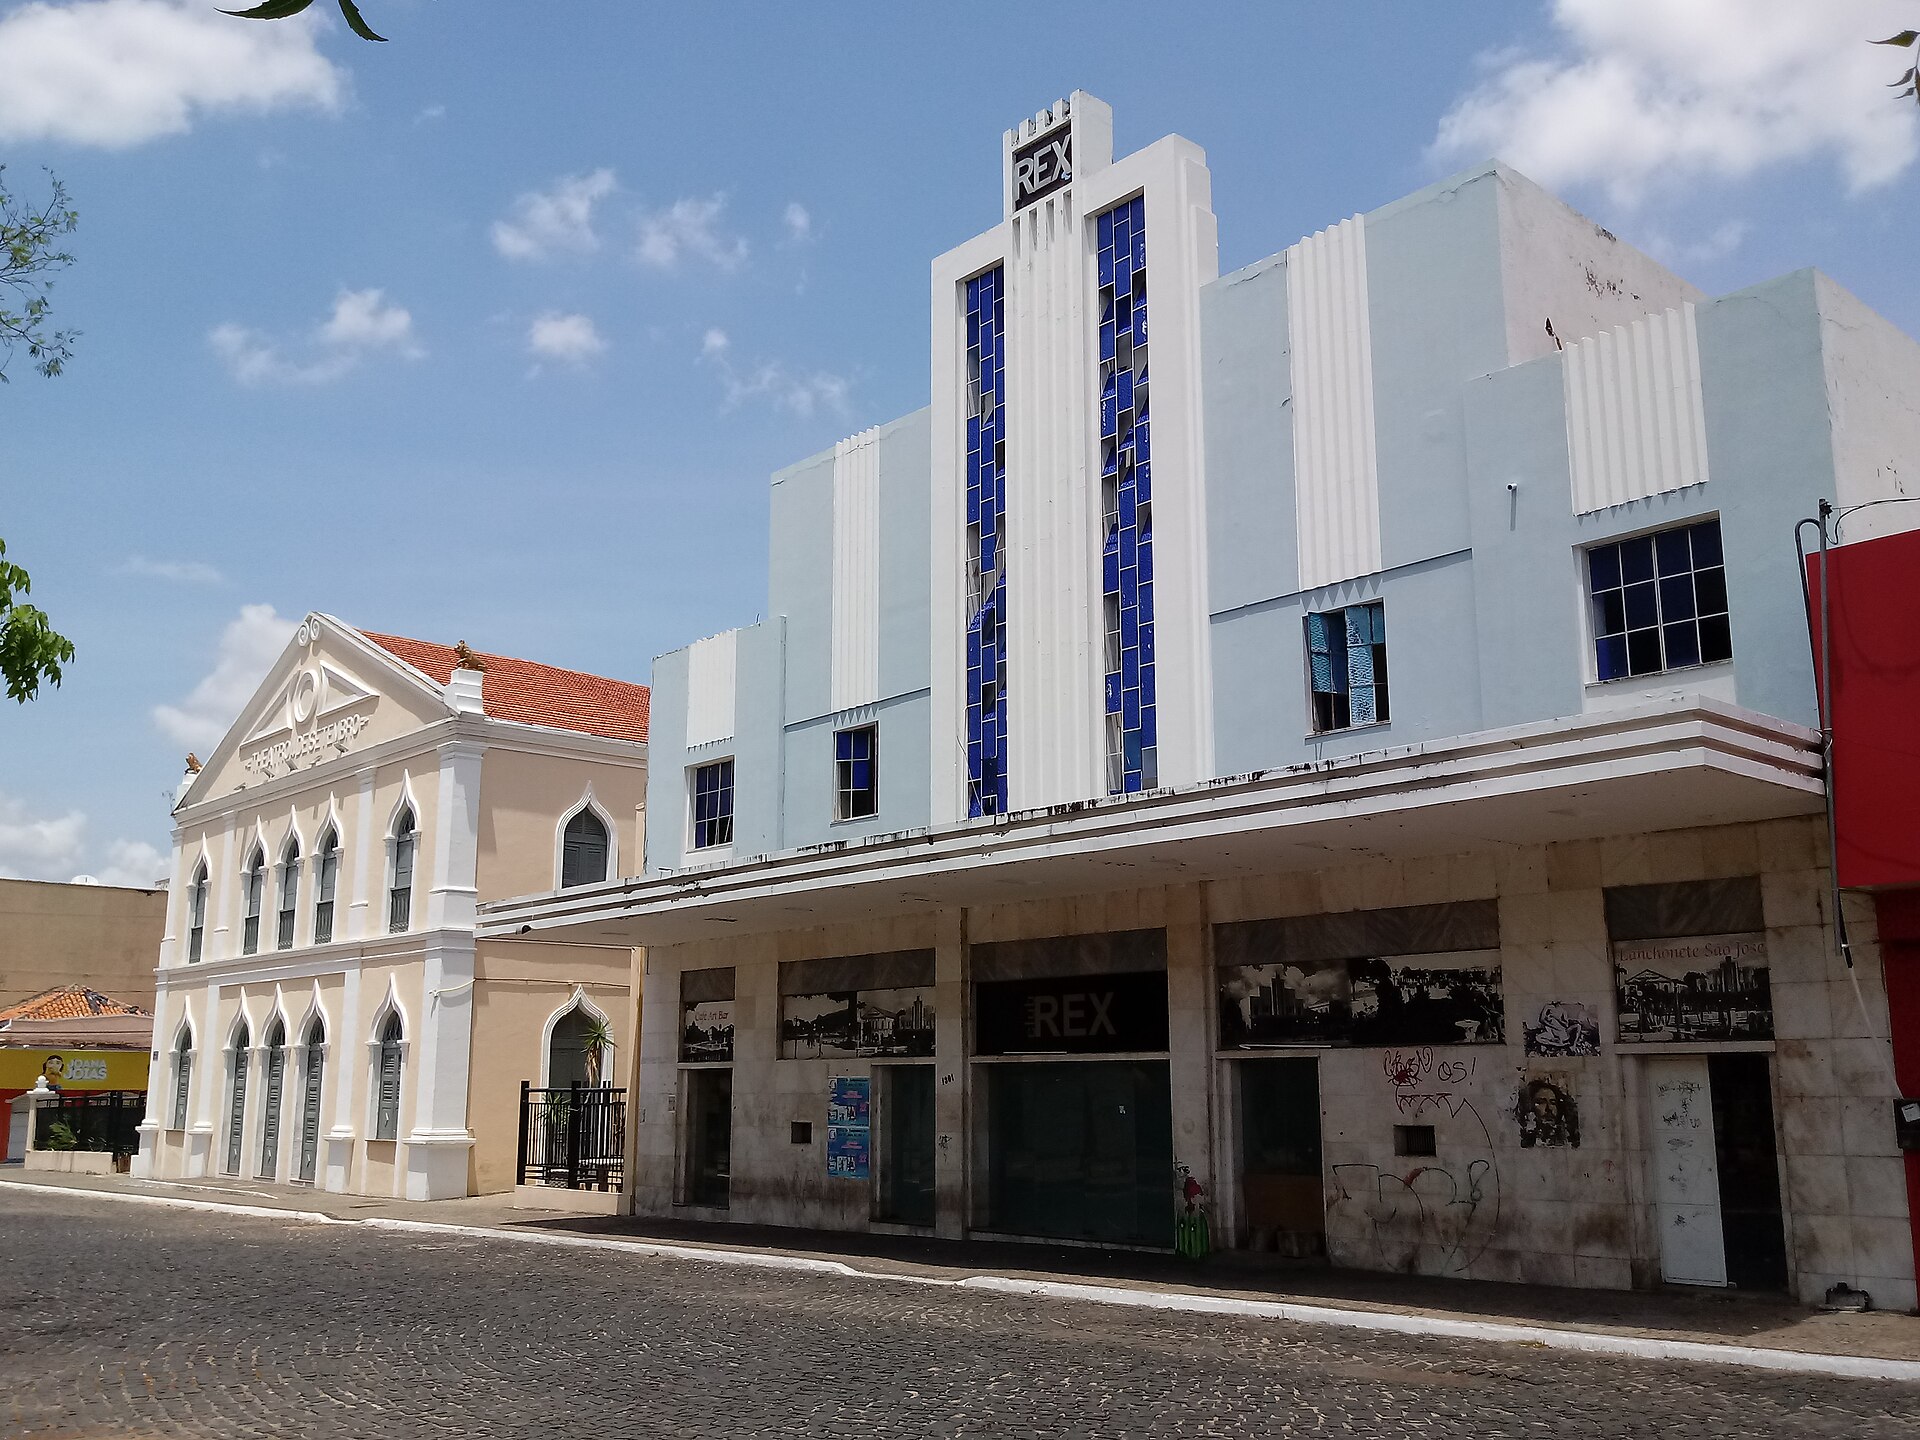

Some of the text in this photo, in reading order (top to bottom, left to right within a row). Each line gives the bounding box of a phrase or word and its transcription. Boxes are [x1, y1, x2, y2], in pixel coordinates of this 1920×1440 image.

[1013, 133, 1072, 201] REX
[1620, 945, 1699, 961] Lanchonete
[1034, 991, 1117, 1038] REX
[64, 1067, 107, 1080] JOIAS
